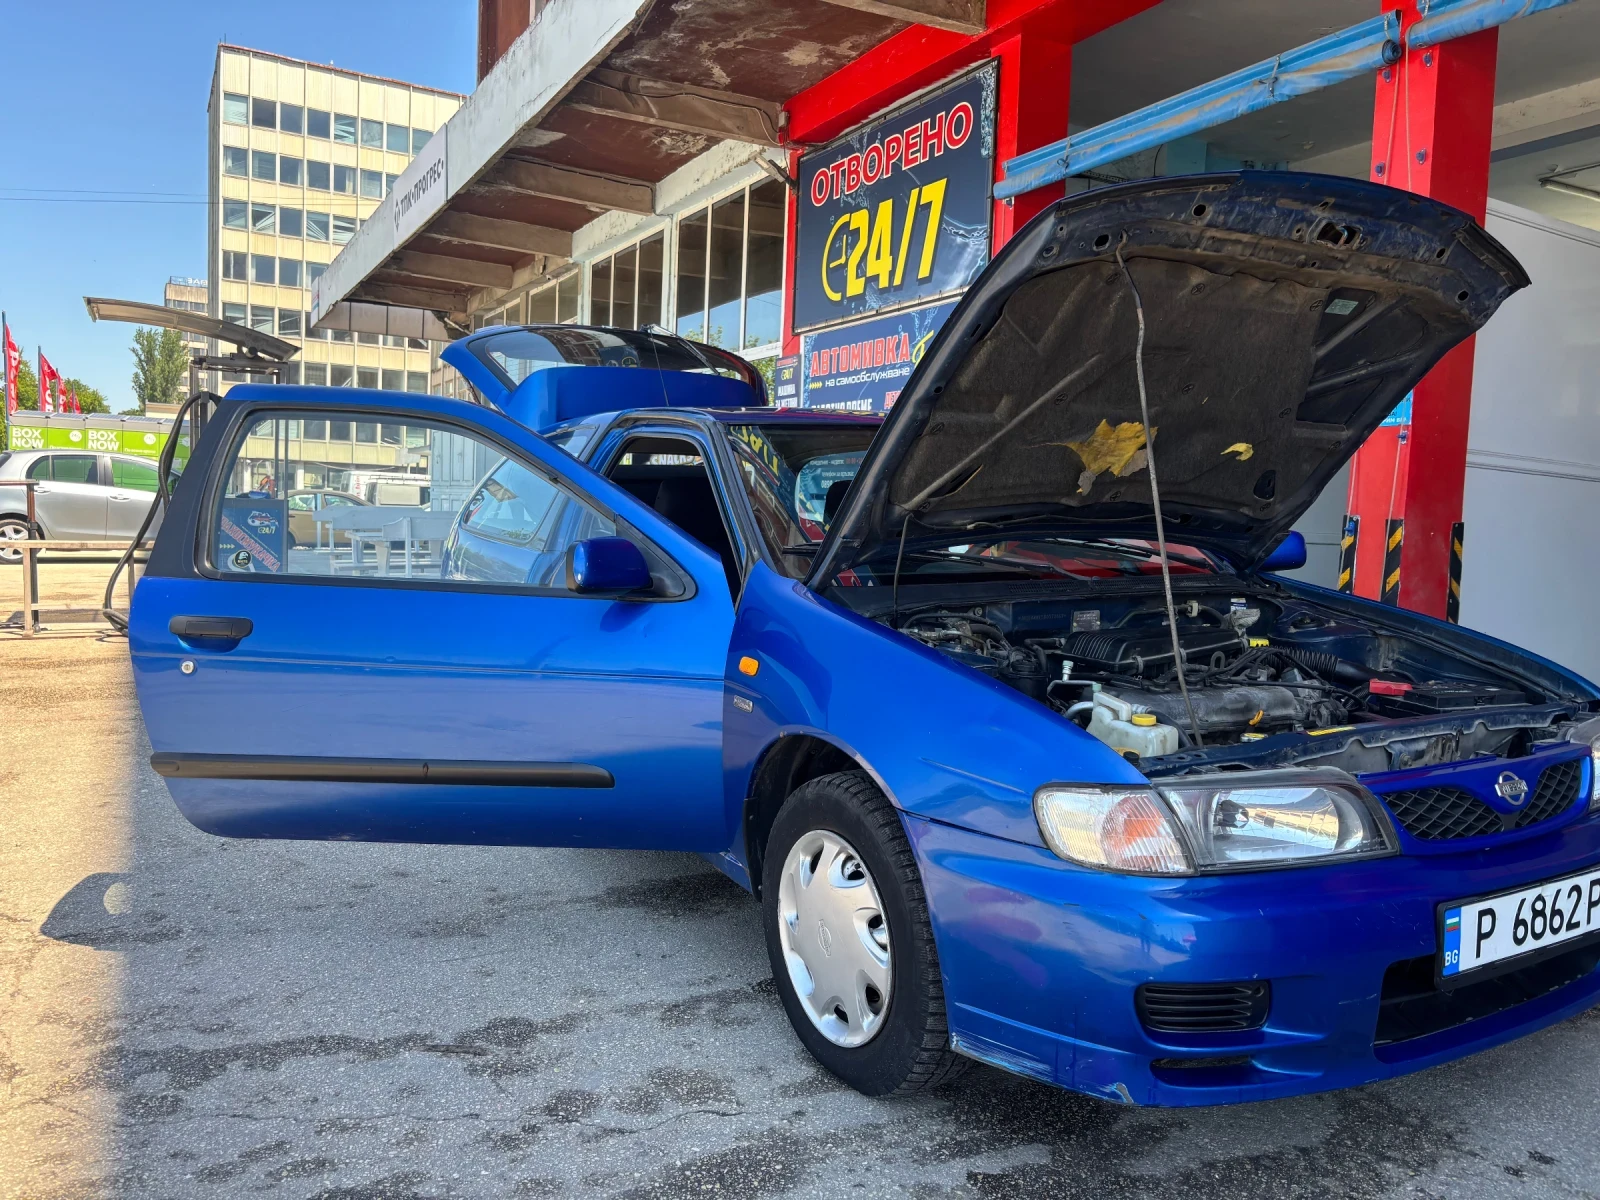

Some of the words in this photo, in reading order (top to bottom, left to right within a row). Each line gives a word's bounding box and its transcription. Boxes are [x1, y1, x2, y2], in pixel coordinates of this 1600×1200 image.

[811, 101, 974, 207] ОТВОРЕНО
[845, 177, 949, 298] 24/7
[810, 332, 911, 378] АВТОМИВКА
[825, 379, 835, 388] на
[836, 367, 910, 387] самообслужване
[12, 427, 42, 439] BOX
[88, 430, 118, 442] BOX
[12, 438, 44, 448] NOW
[88, 440, 120, 450] NOW
[1475, 907, 1497, 959] P
[1444, 949, 1459, 967] BG
